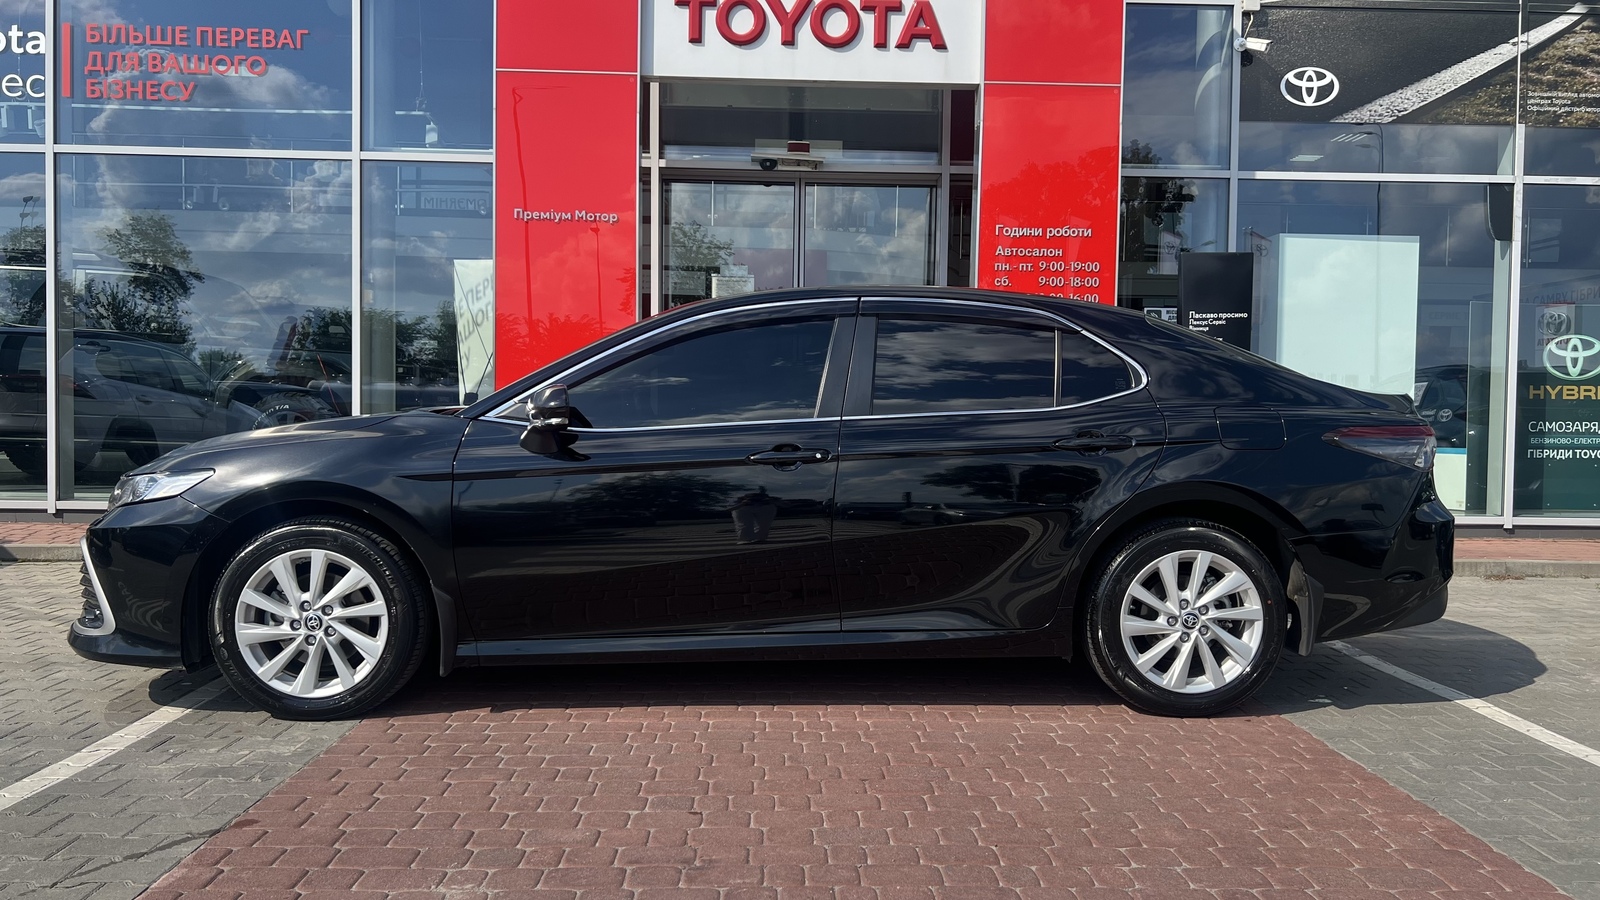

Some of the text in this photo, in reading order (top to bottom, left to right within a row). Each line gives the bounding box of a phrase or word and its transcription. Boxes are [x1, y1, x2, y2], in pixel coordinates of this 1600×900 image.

[674, 0, 947, 49] TOYOTA
[85, 23, 309, 49] БІЛЬШЕ ПЕРЕВАГ
[84, 51, 268, 76] ДЛЯ ВАШОГО
[85, 79, 196, 101] БІЗНЕСУ
[513, 208, 618, 224] Преміум Мотор
[995, 224, 1092, 239] Години роботи
[995, 246, 1063, 256] Автосалон
[1038, 261, 1100, 272] 9:00-19:00
[994, 276, 1100, 287] сб. 9:00-18:00
[1189, 310, 1218, 318] Ласкаво
[1528, 421, 1600, 434] САМОЗАРЯ
[1528, 450, 1572, 460] ГІБРИДИ
